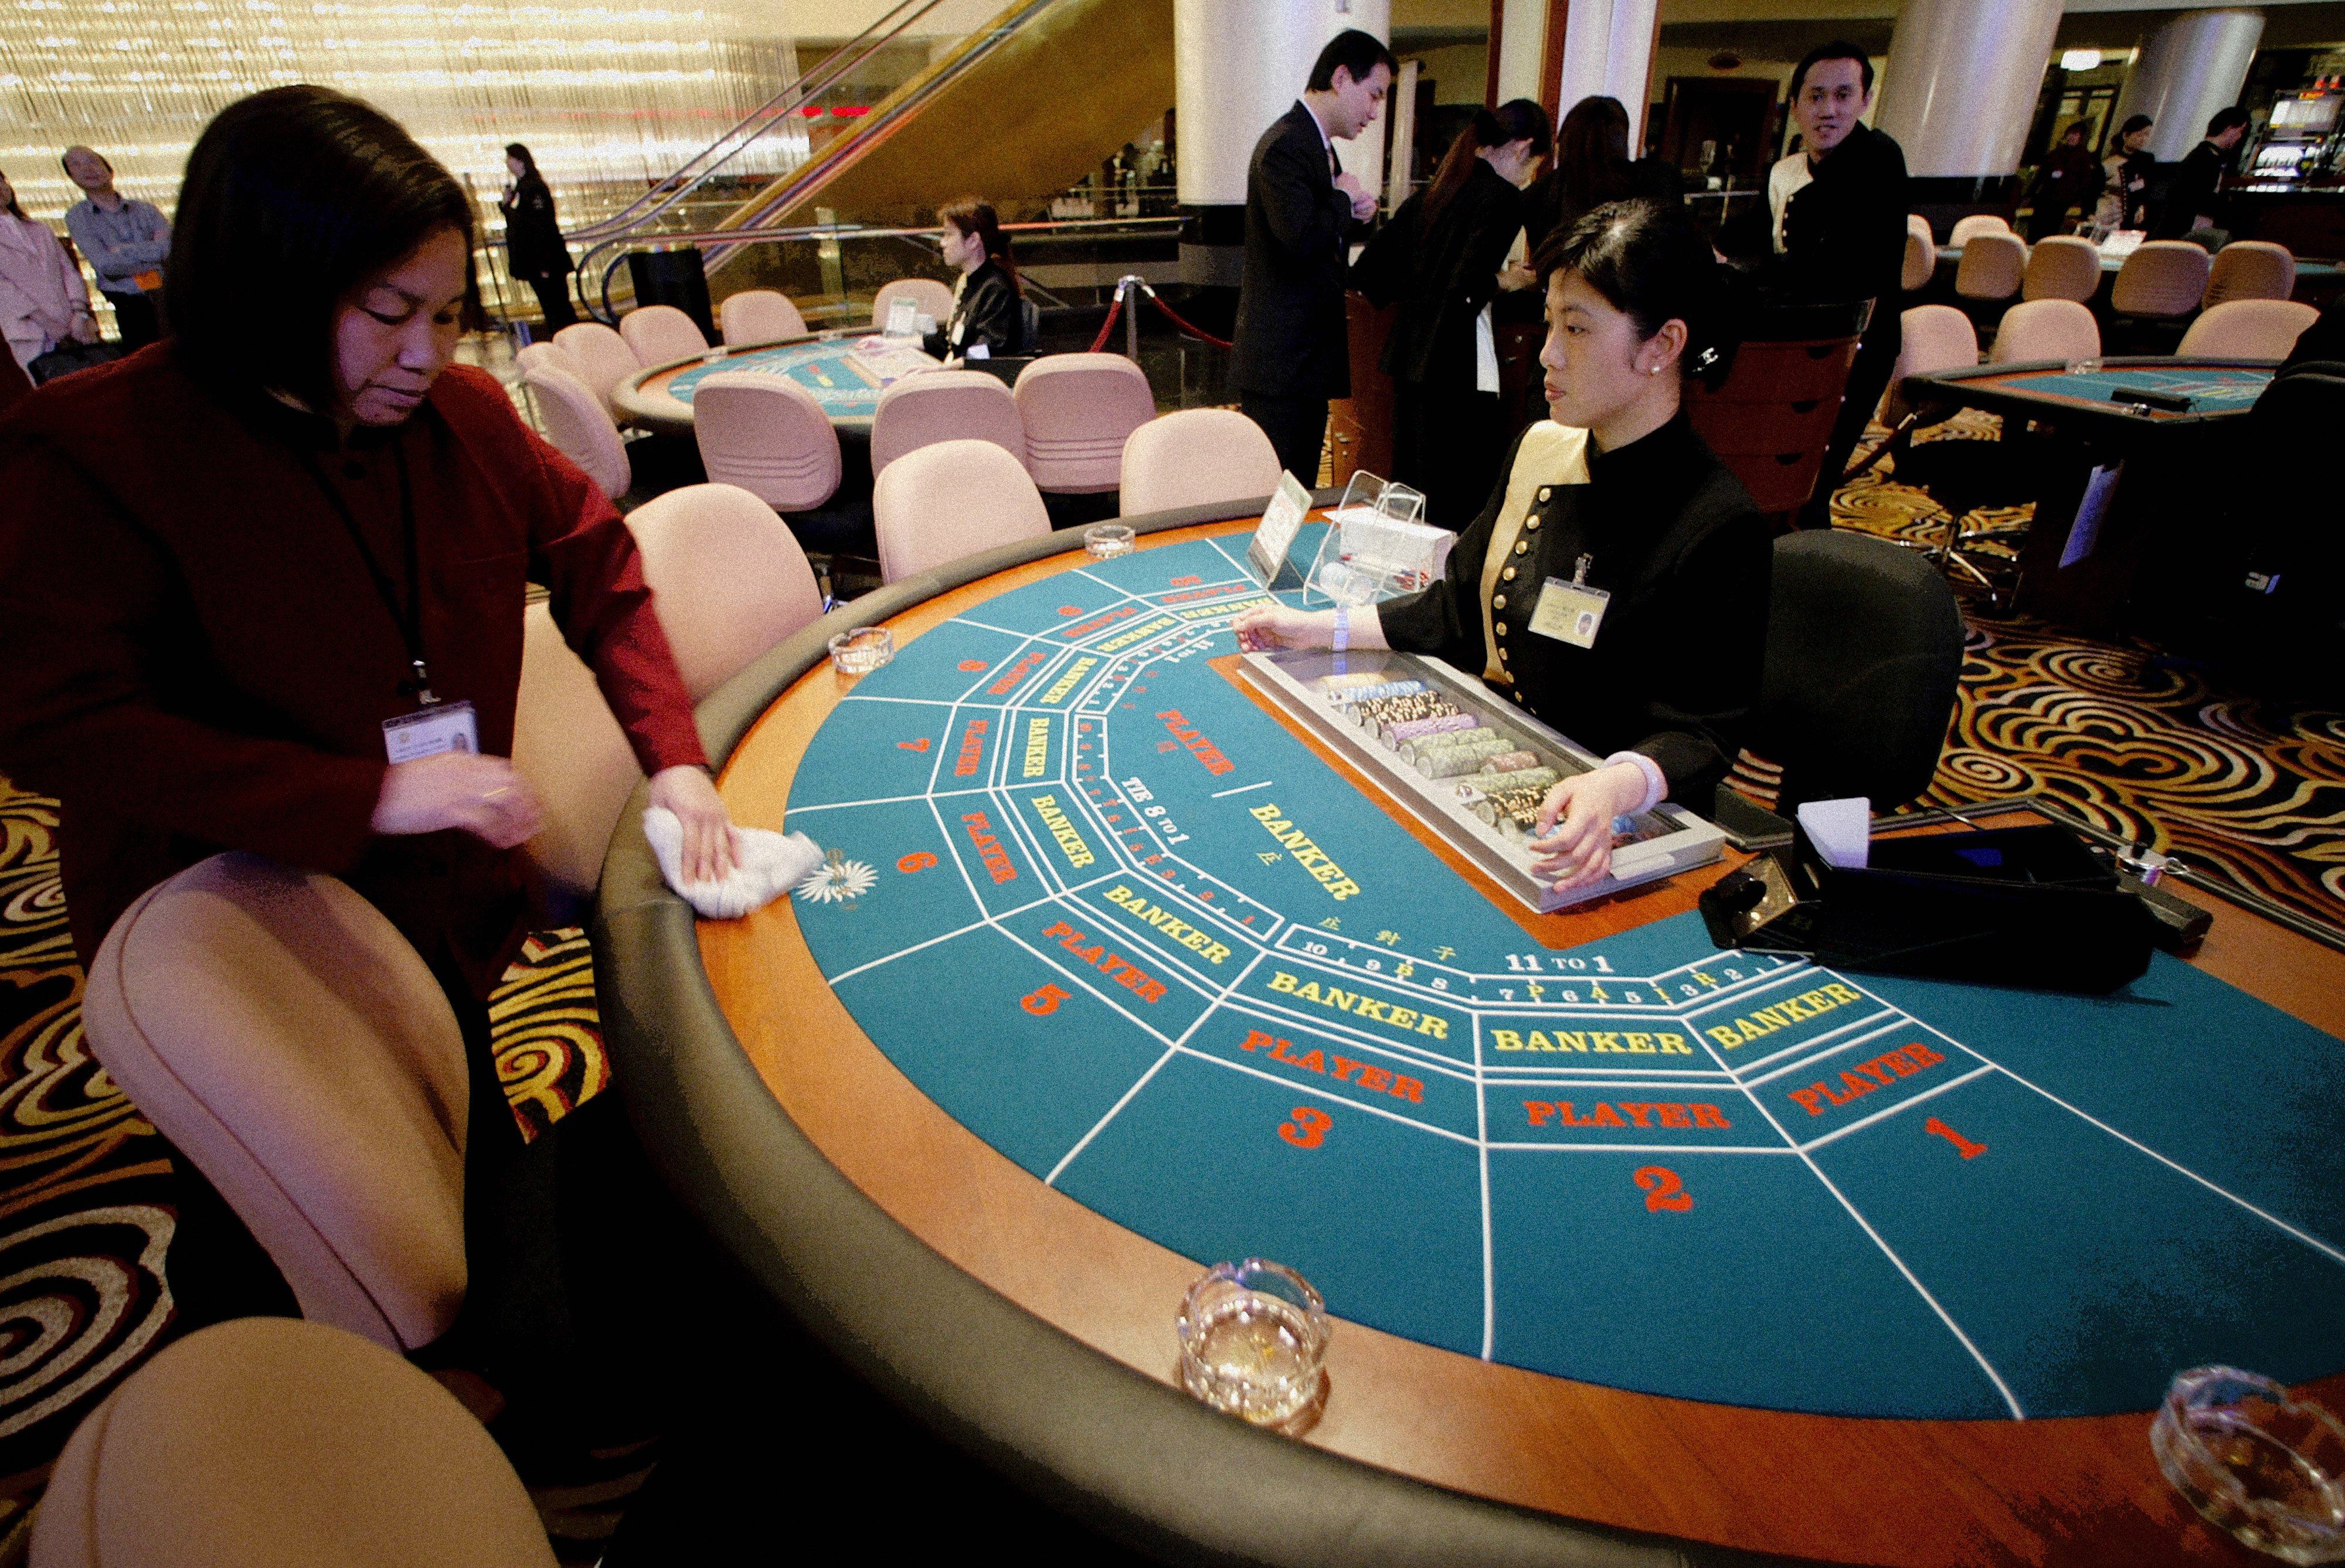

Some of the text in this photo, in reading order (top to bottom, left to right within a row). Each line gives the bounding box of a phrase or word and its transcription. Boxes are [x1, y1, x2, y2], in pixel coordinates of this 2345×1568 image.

[1096, 615, 1175, 652] BANKER
[987, 652, 1046, 695] PLAYER
[1040, 656, 1097, 703] BANKER
[897, 737, 931, 753] 7
[954, 719, 989, 777] PLAYER
[1024, 717, 1050, 777] BANKER
[1156, 709, 1235, 776] PLAYER
[1032, 795, 1095, 868] BANKER
[1121, 776, 1191, 846] TIE 8 TO 1
[896, 851, 939, 874] 6
[961, 811, 1018, 885] PLAYER
[1249, 802, 1361, 901] BANKER
[1103, 885, 1231, 965] BANKER
[1042, 920, 1168, 1004] PLAYER
[1301, 941, 1328, 958] 10
[1365, 959, 1382, 971] 9
[1430, 977, 1449, 991] 8
[1498, 988, 1514, 1003] 7
[1561, 989, 1579, 1002] 6
[1624, 991, 1642, 1004] 5
[1680, 984, 1702, 999] 3
[1505, 953, 1615, 974] 11 TO 1
[1019, 982, 1072, 1016] 5
[1266, 971, 1449, 1040] BANKER
[1705, 982, 1863, 1050] BANKER
[1239, 1029, 1425, 1104] PLAYER
[1492, 1029, 1693, 1056] BANKER
[1787, 1042, 1946, 1117] PLAYER
[1277, 1106, 1333, 1149] 3
[1522, 1100, 1732, 1130] PLAYER
[1924, 1116, 1988, 1160] 1
[1632, 1165, 1694, 1213] 2
